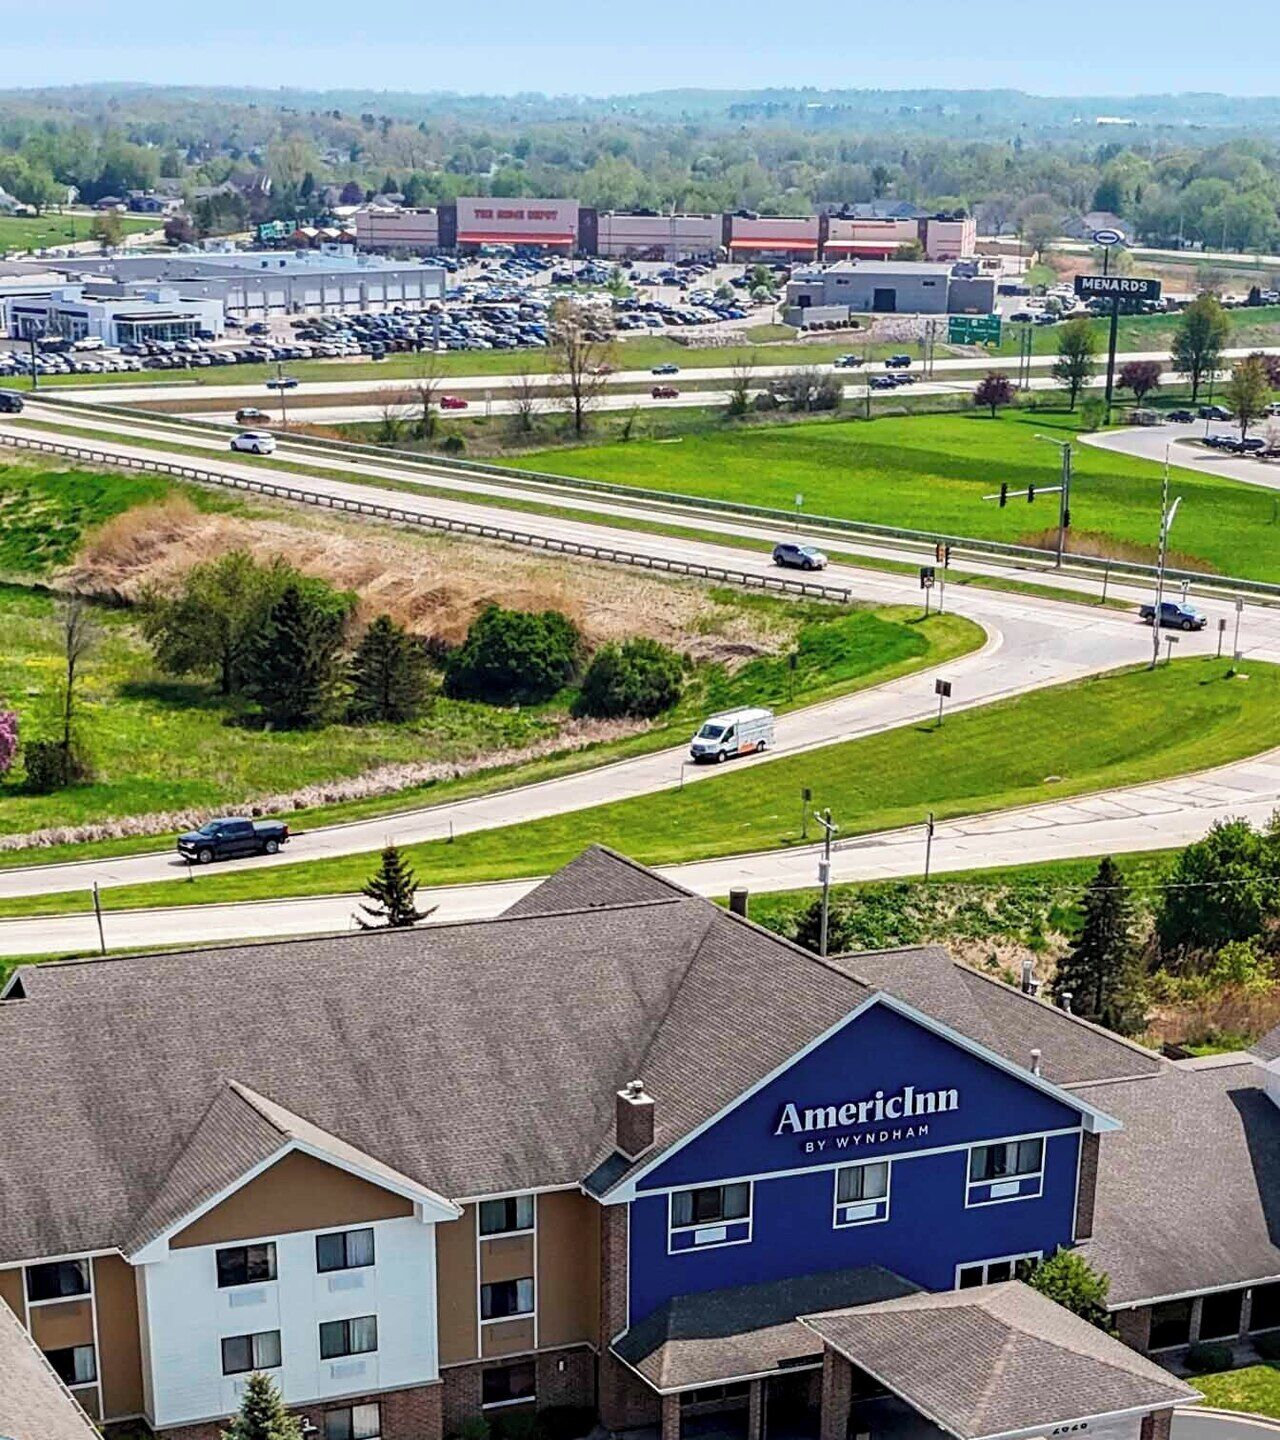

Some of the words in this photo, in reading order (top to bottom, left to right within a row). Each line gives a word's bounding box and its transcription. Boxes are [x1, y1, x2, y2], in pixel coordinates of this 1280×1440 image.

[1082, 278, 1147, 292] MENARDS
[774, 1086, 959, 1136] AmericInn
[805, 1140, 827, 1154] BY
[836, 1124, 929, 1149] WYNDHAM
